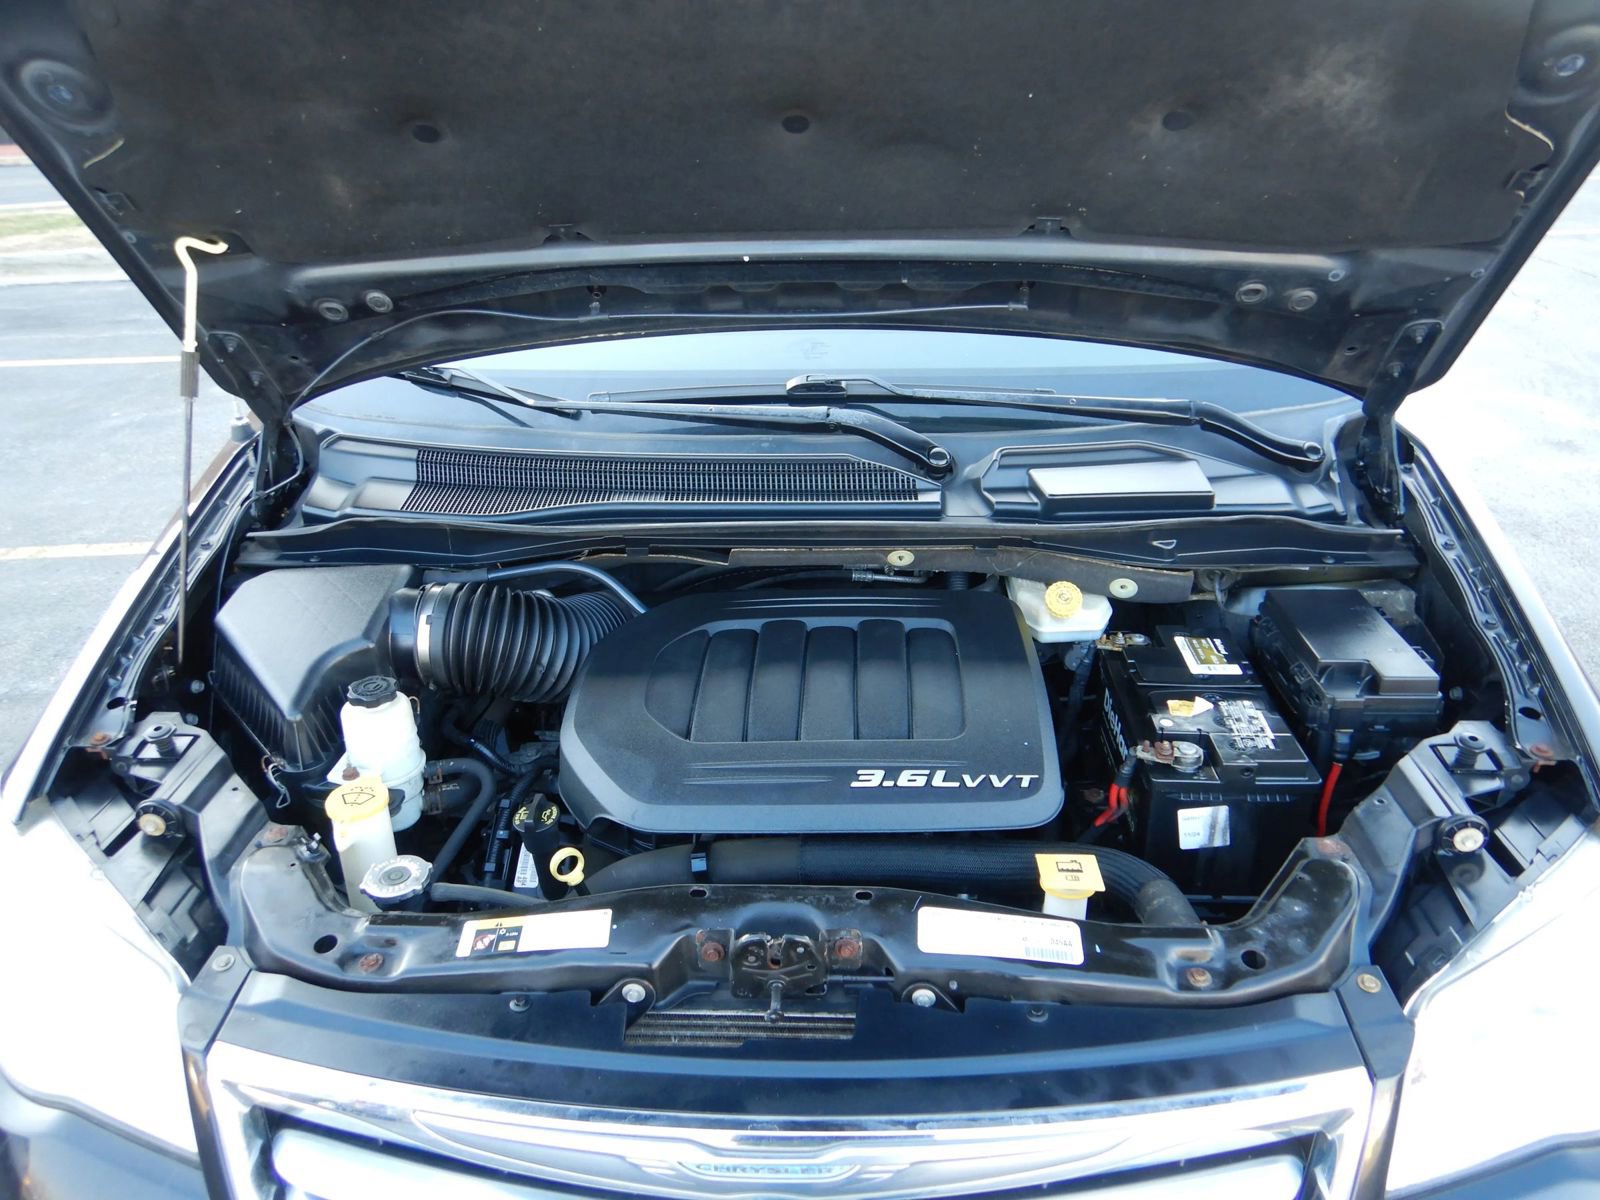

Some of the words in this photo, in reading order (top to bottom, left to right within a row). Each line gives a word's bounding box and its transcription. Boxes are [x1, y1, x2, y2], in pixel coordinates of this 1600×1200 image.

[1104, 687, 1129, 761] DieHar
[850, 769, 960, 788] 3.6L
[961, 774, 1040, 788] VVT
[696, 1163, 833, 1175] CHRYSLER
